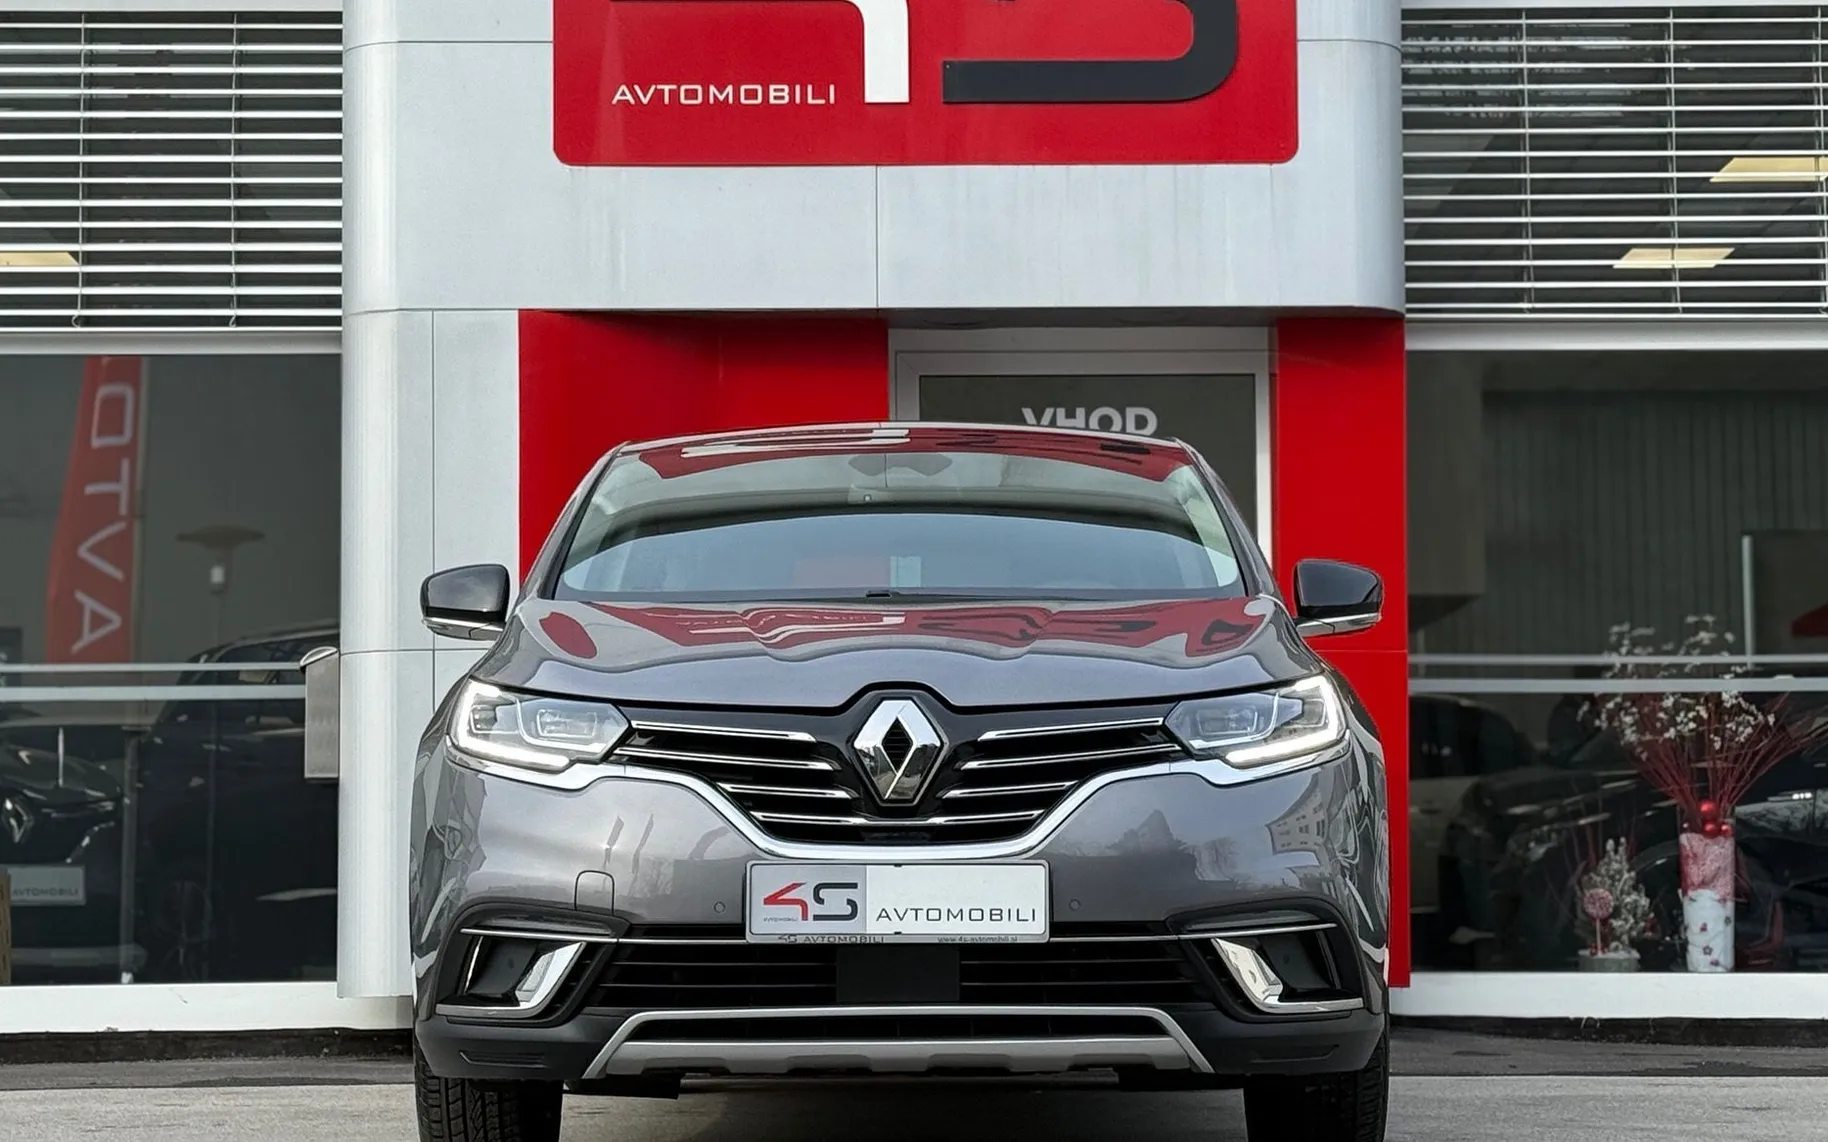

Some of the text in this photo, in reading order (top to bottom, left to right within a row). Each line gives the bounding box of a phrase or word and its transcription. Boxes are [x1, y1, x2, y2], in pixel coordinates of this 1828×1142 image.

[612, 84, 835, 104] AVTOMOBILI
[1021, 406, 1158, 437] VHOD
[763, 882, 859, 921] 4S
[876, 908, 1036, 922] AVTOMOBILI
[803, 935, 884, 944] AVTOMOBILI
